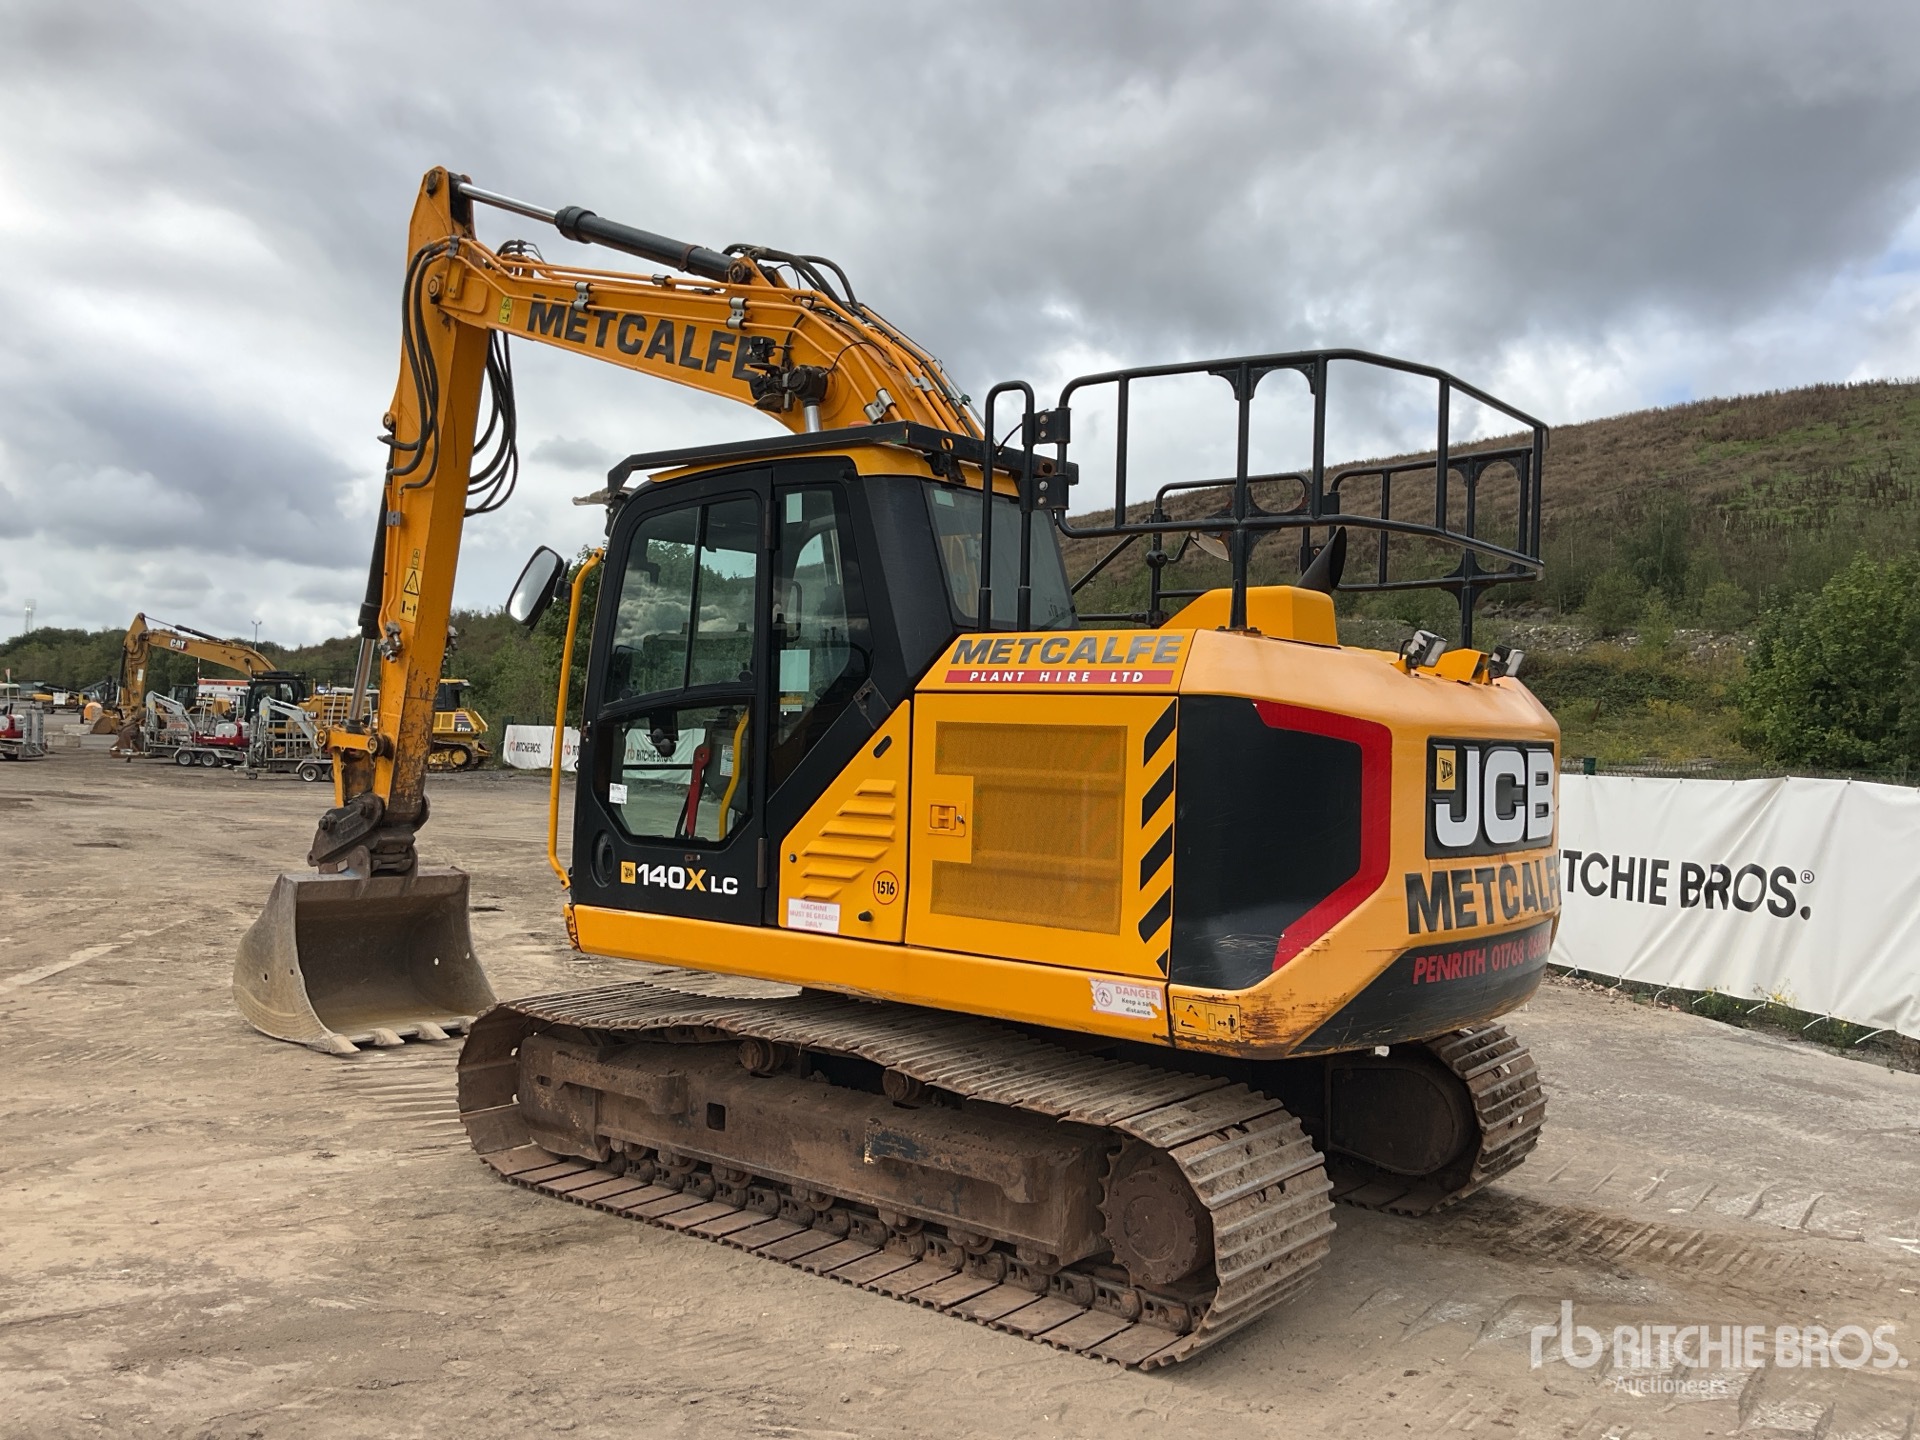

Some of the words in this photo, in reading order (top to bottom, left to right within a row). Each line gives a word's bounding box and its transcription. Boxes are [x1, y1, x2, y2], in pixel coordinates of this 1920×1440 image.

[527, 293, 761, 382] METCALFE
[170, 638, 186, 650] CAT
[951, 636, 1185, 665] METCALFE
[969, 671, 1025, 683] PLANT
[1039, 671, 1091, 683] HIRE
[1109, 671, 1144, 683] LTD
[1436, 749, 1554, 847] JCB
[637, 863, 707, 892] 140X
[710, 876, 738, 895] LC
[877, 880, 895, 895] 1516
[800, 903, 827, 911] MACHINE
[790, 910, 805, 918] MUST
[805, 920, 823, 929] DAILY
[1412, 947, 1486, 985] PENRITH
[1491, 938, 1525, 972] 01768
[1115, 986, 1158, 1000] DANGER
[1121, 997, 1136, 1006] Keep
[1125, 1006, 1151, 1016] distance
